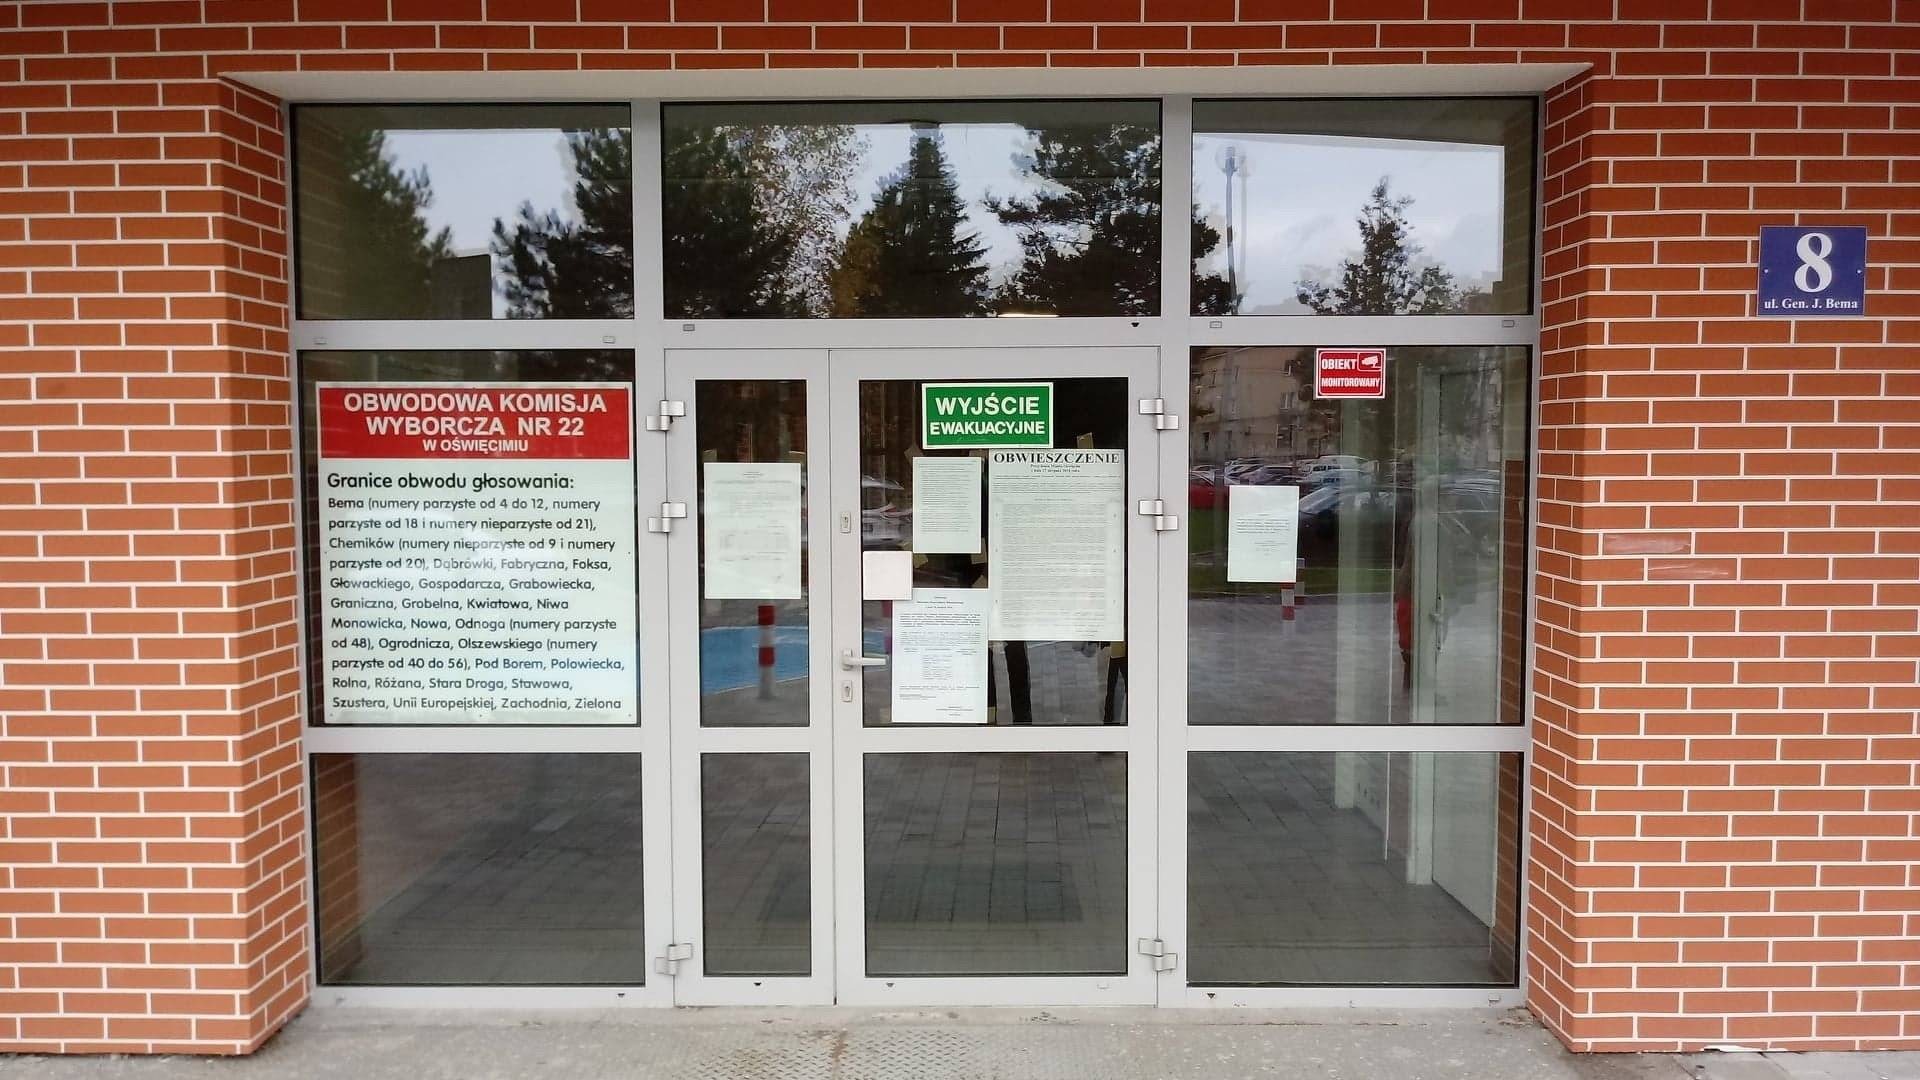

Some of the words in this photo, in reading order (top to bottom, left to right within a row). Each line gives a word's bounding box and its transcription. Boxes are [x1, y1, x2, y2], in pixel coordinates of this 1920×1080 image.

[1794, 233, 1832, 293] 8
[1765, 299, 1778, 308] ul.
[1782, 299, 1808, 308] Gen.
[1812, 299, 1821, 308] J.
[1826, 299, 1857, 308] Bema
[1322, 359, 1356, 369] OBIEKT
[1322, 378, 1380, 387] MONITOROWANY
[344, 393, 493, 412] OBWODOWA
[500, 393, 606, 412] KOMISJA
[936, 393, 1039, 415] WYJŚCIE
[366, 416, 505, 436] WYBORCZA
[518, 417, 551, 436] NR
[558, 417, 584, 436] 22
[930, 421, 1045, 435] EWAKUACYJNE
[423, 439, 437, 451] W
[441, 436, 528, 454] OŚWIĘCIMIU
[994, 453, 1120, 463] OBWIESZCZENIE
[327, 473, 392, 488] Granice
[398, 473, 466, 488] obwodu
[472, 473, 574, 492] głosowania:
[328, 499, 364, 509] Bema
[368, 498, 419, 512] (numery
[424, 499, 476, 512] parzyste
[480, 498, 496, 509] od
[500, 498, 508, 509] 4
[512, 498, 528, 509] do
[531, 498, 548, 511] 12,
[553, 500, 600, 513] numery
[329, 518, 381, 531] parzyste
[386, 518, 402, 529] od
[405, 518, 418, 529] 18
[430, 520, 477, 532] numery
[481, 518, 552, 532] nieparzyste
[556, 518, 572, 529] od
[576, 518, 597, 532] 21),
[329, 538, 394, 550] Chemików
[398, 538, 449, 552] (numery
[453, 538, 525, 552] nieparzyste
[529, 538, 544, 550] od
[548, 538, 556, 550] 9
[568, 540, 615, 552] numery
[330, 558, 382, 572] parzyste
[386, 558, 402, 569] od
[406, 558, 429, 570] 20),
[433, 557, 497, 572] Dąbrówki,
[501, 558, 568, 573] Fabryczna,
[573, 559, 612, 572] Foksa,
[330, 578, 414, 591] Głowackiego,
[419, 578, 505, 591] Gospodarcza,
[509, 578, 595, 591] Grabowiecka,
[331, 597, 397, 611] Graniczna,
[402, 598, 462, 611] Grobelna,
[467, 598, 532, 611] Kwiatowa,
[537, 598, 569, 610] Niwa
[331, 618, 406, 631] Monowicka,
[410, 619, 451, 631] Nowa,
[455, 618, 505, 633] Odnoga
[509, 618, 560, 633] (numery
[564, 619, 617, 633] parzyste
[331, 638, 347, 649] od
[352, 638, 374, 650] 48),
[379, 638, 454, 652] Ogrodnicza,
[458, 638, 543, 652] Olszewskiego
[547, 638, 598, 652] (numery
[332, 657, 384, 671] parzyste
[388, 658, 404, 668] od
[408, 658, 424, 669] 40
[428, 658, 443, 668] do
[448, 658, 471, 671] 56),
[475, 659, 499, 669] Pod
[503, 659, 546, 671] Borem,
[551, 658, 625, 671] Polowiecka,
[333, 677, 371, 690] Rolna,
[375, 677, 425, 690] Różana,
[429, 678, 461, 689] Stara
[466, 678, 508, 691] Droga,
[512, 678, 573, 691] Stawowa,
[333, 697, 389, 709] Szustera,
[393, 697, 417, 708] Unii
[421, 697, 497, 711] Europejskiej,
[502, 698, 571, 710] Zachodnia,
[575, 698, 621, 709] Zielona
